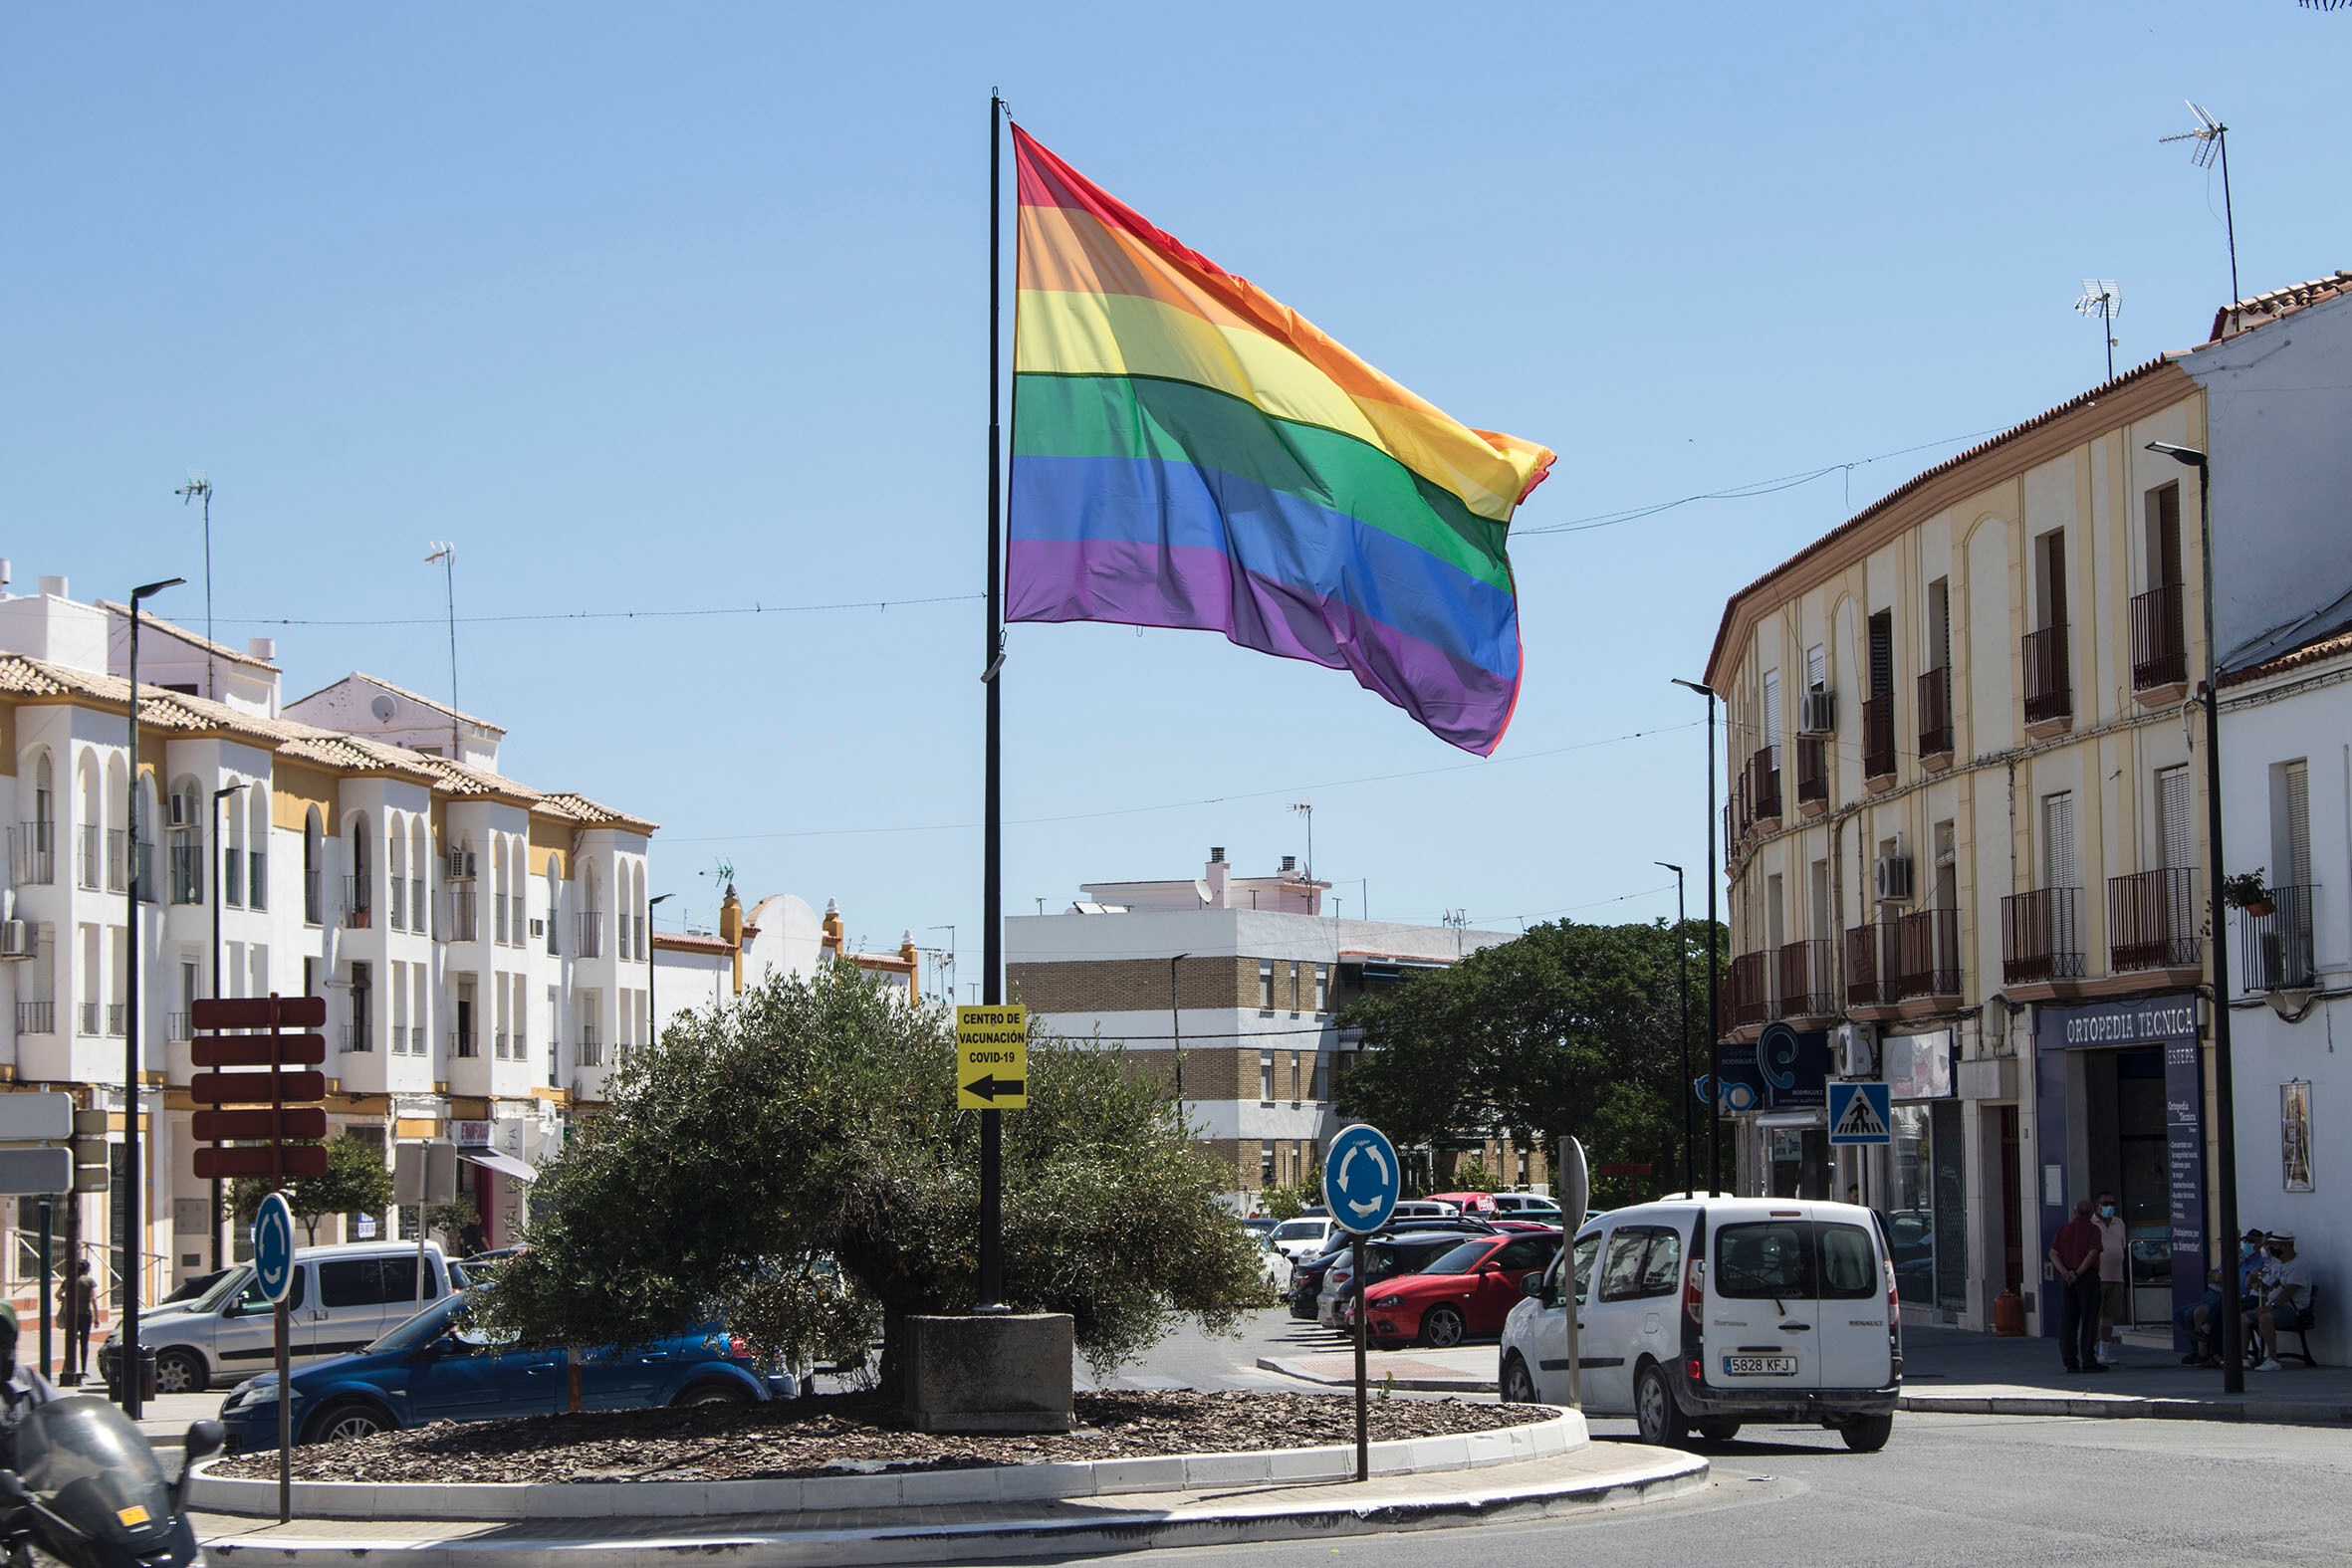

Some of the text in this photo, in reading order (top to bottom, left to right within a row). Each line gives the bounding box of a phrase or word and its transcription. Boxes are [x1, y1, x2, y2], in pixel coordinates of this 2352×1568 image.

[963, 1012, 1021, 1024] CENTRO DE
[2066, 1004, 2195, 1043] ORTOPEDIA TÉCNICA
[959, 1030, 1025, 1043] VACUNACIÓN
[969, 1051, 1016, 1063] COVID-19
[2168, 1047, 2195, 1064] ESTEPA
[1732, 1359, 1789, 1371] 5828 KFJ
